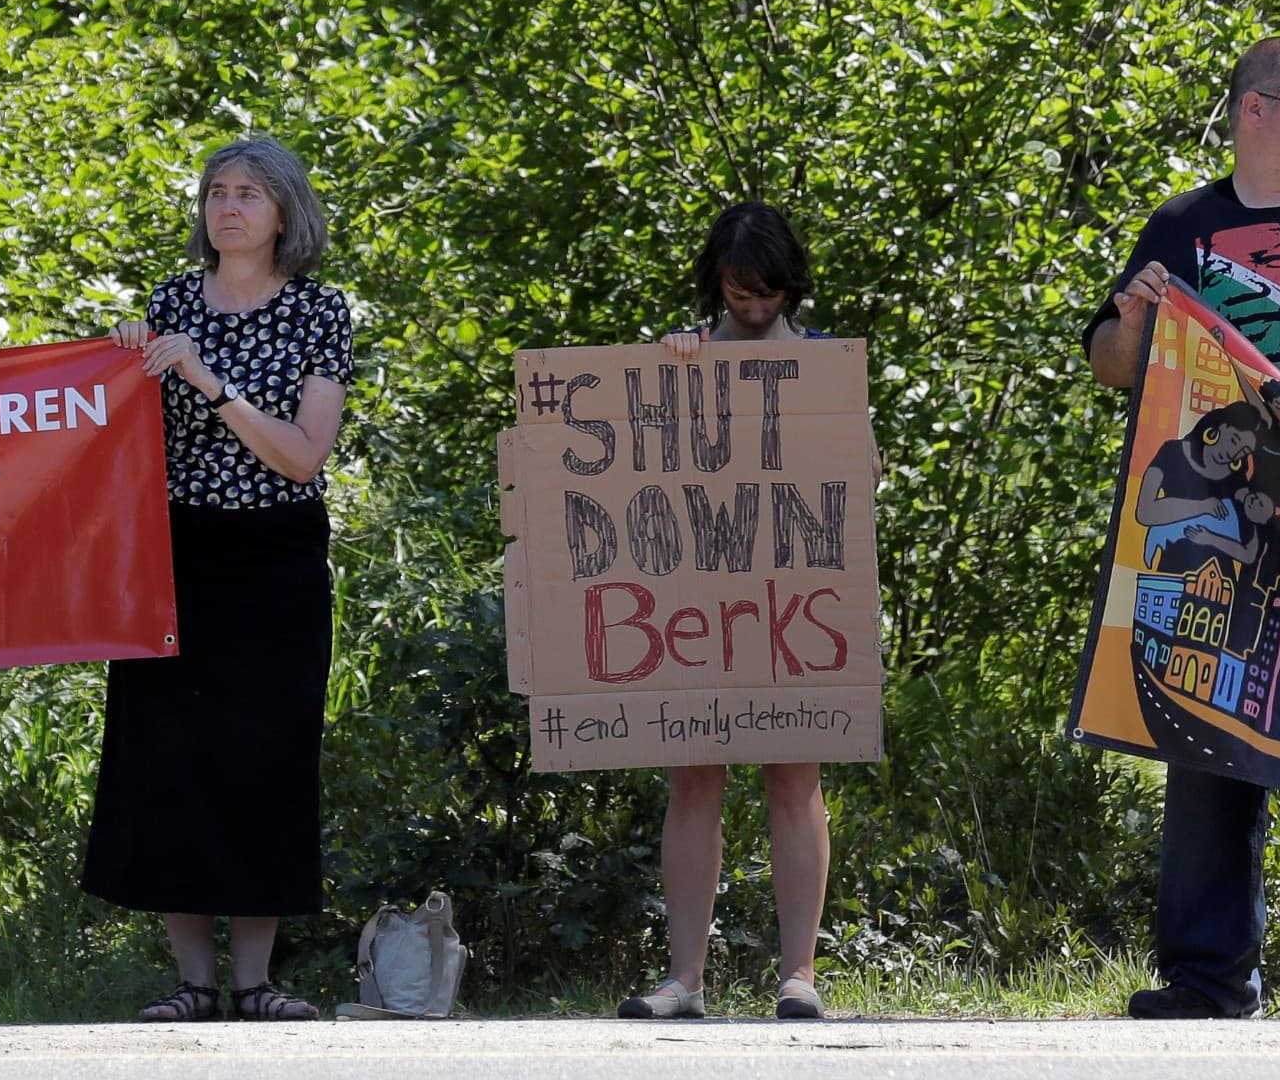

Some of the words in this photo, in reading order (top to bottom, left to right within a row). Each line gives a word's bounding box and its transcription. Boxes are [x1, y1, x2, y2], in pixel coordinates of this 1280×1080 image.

[529, 360, 799, 476] #SHUT
[564, 481, 847, 582] DOWN
[584, 579, 848, 684] Berks
